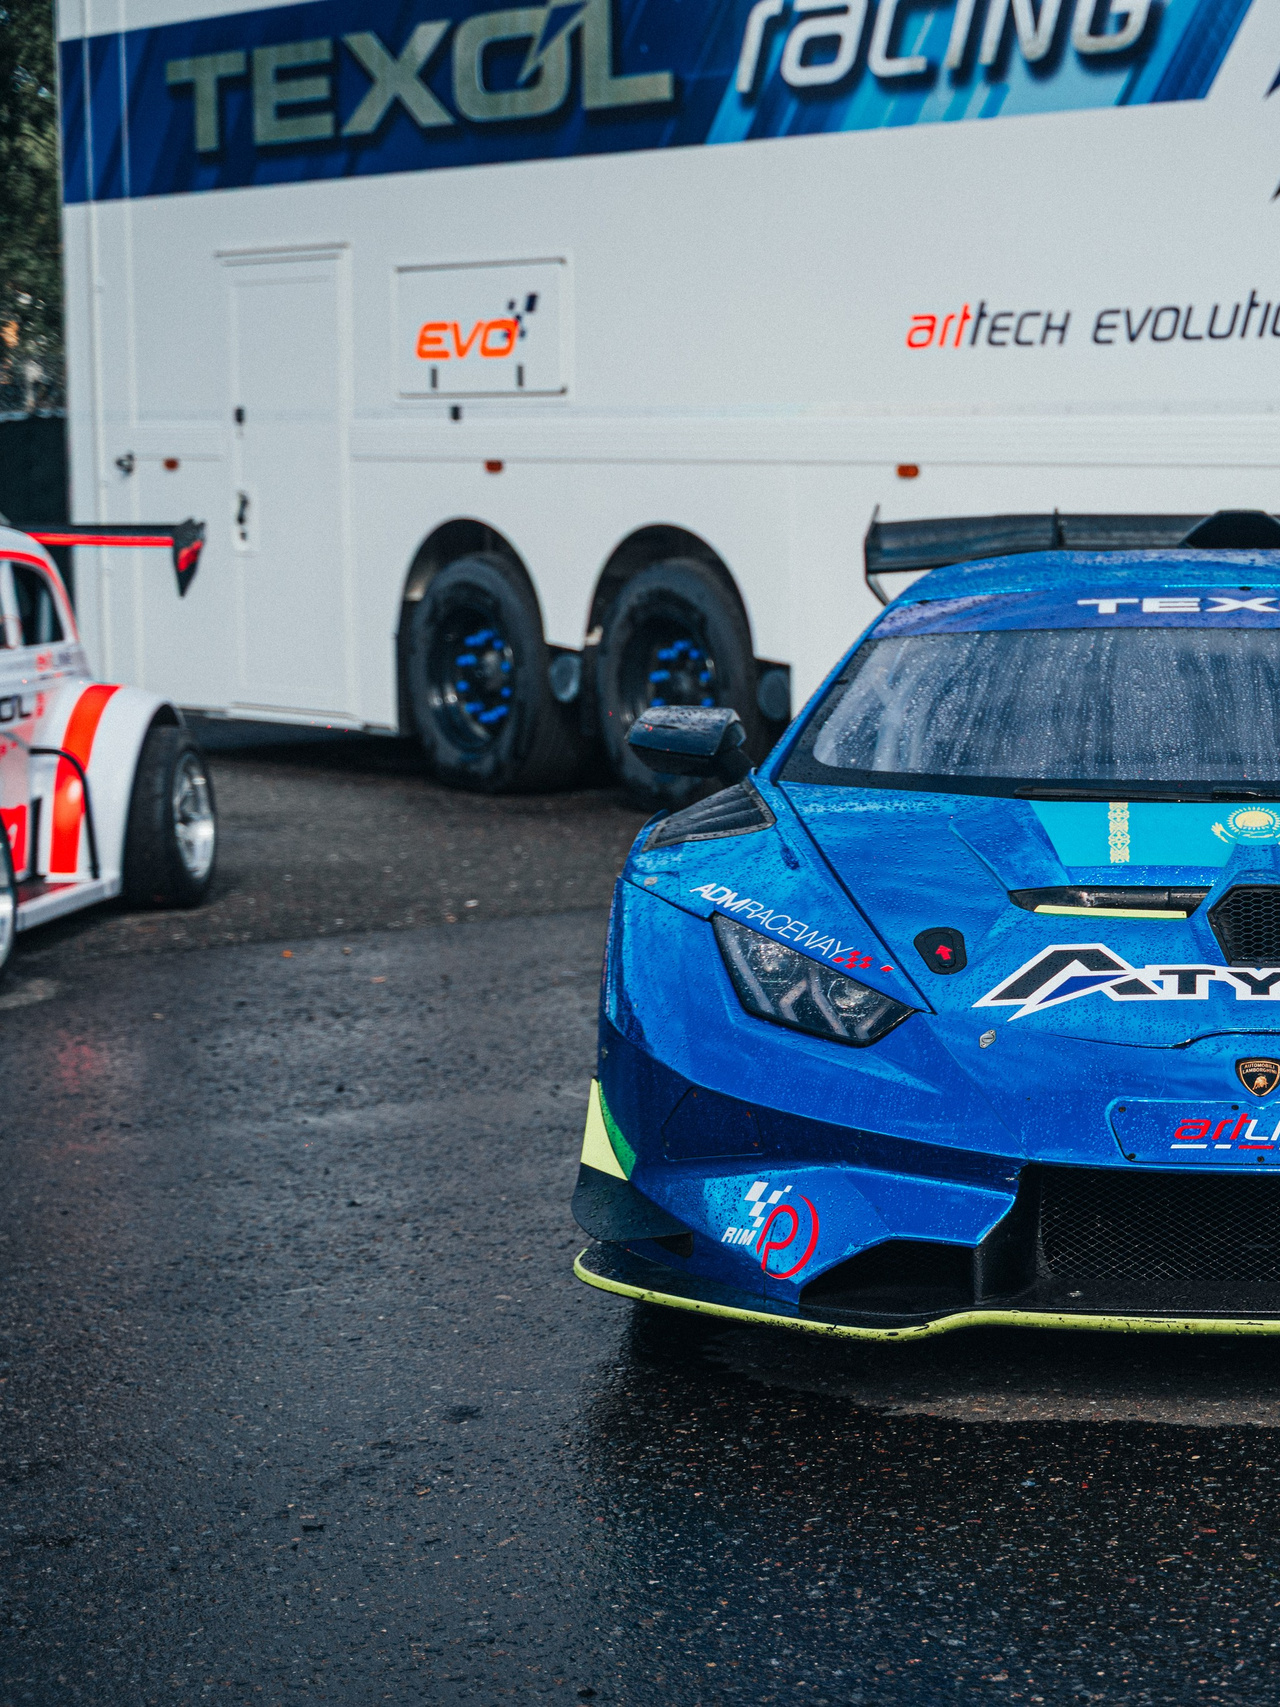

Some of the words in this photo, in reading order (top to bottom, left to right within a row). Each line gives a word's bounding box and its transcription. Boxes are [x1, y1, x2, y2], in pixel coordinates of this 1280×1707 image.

[166, 0, 675, 154] TEXOL
[416, 318, 519, 359] EVO
[720, 1226, 758, 1246] RIM
